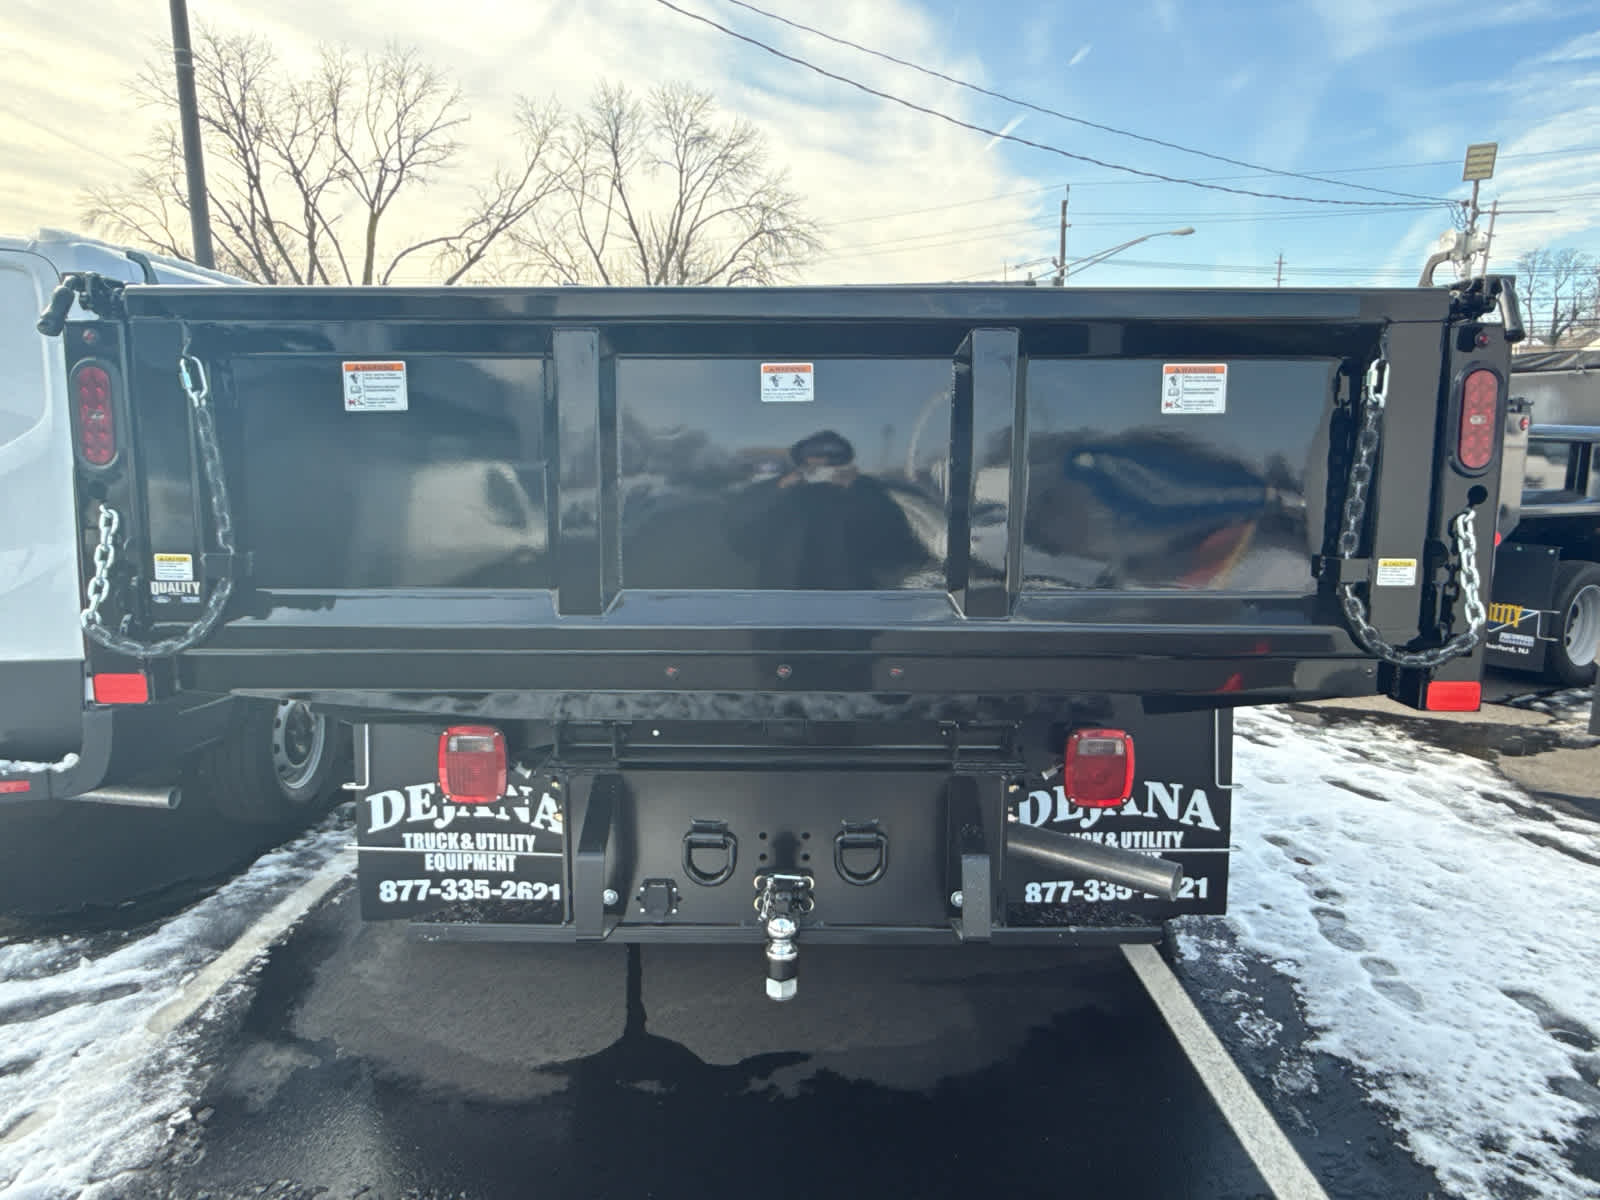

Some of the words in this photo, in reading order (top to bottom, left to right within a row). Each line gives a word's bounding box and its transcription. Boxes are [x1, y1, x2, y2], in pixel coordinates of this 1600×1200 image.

[150, 581, 200, 595] QUALITY
[402, 832, 460, 850] TRUCK
[460, 833, 475, 850] &
[475, 833, 536, 853] UTILITY
[1120, 831, 1184, 849] UTILITY
[424, 853, 517, 873] EQUIPMENT
[378, 879, 561, 902] 877-335-2621
[1024, 877, 1208, 903] 877-335-21
